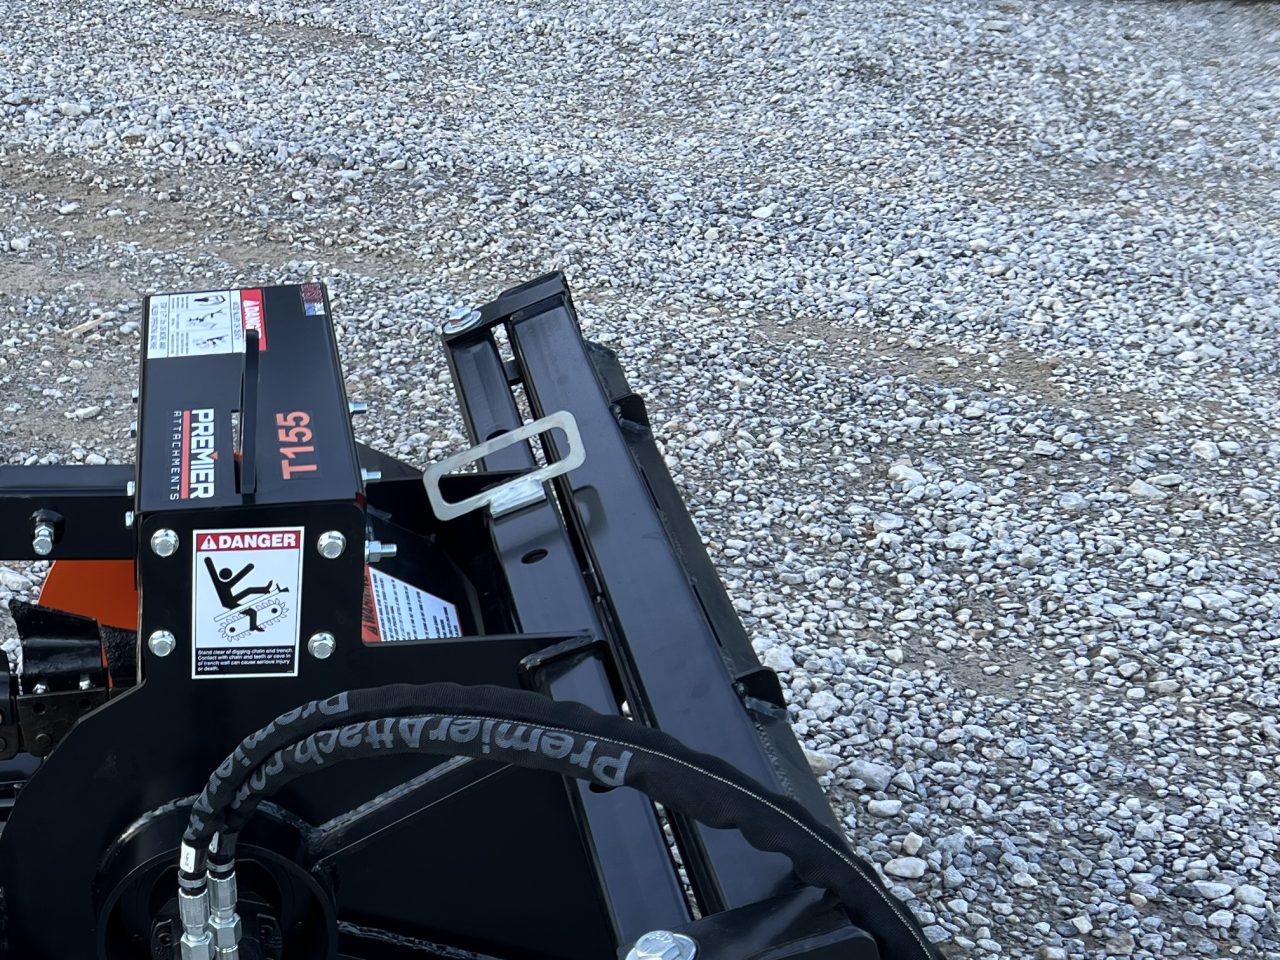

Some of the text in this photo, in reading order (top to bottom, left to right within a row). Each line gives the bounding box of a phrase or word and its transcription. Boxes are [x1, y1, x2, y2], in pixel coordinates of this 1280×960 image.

[170, 410, 182, 500] ATTACHMENTS
[190, 408, 216, 499] PREMIER
[276, 410, 318, 480] T155
[218, 533, 296, 549] DANGER
